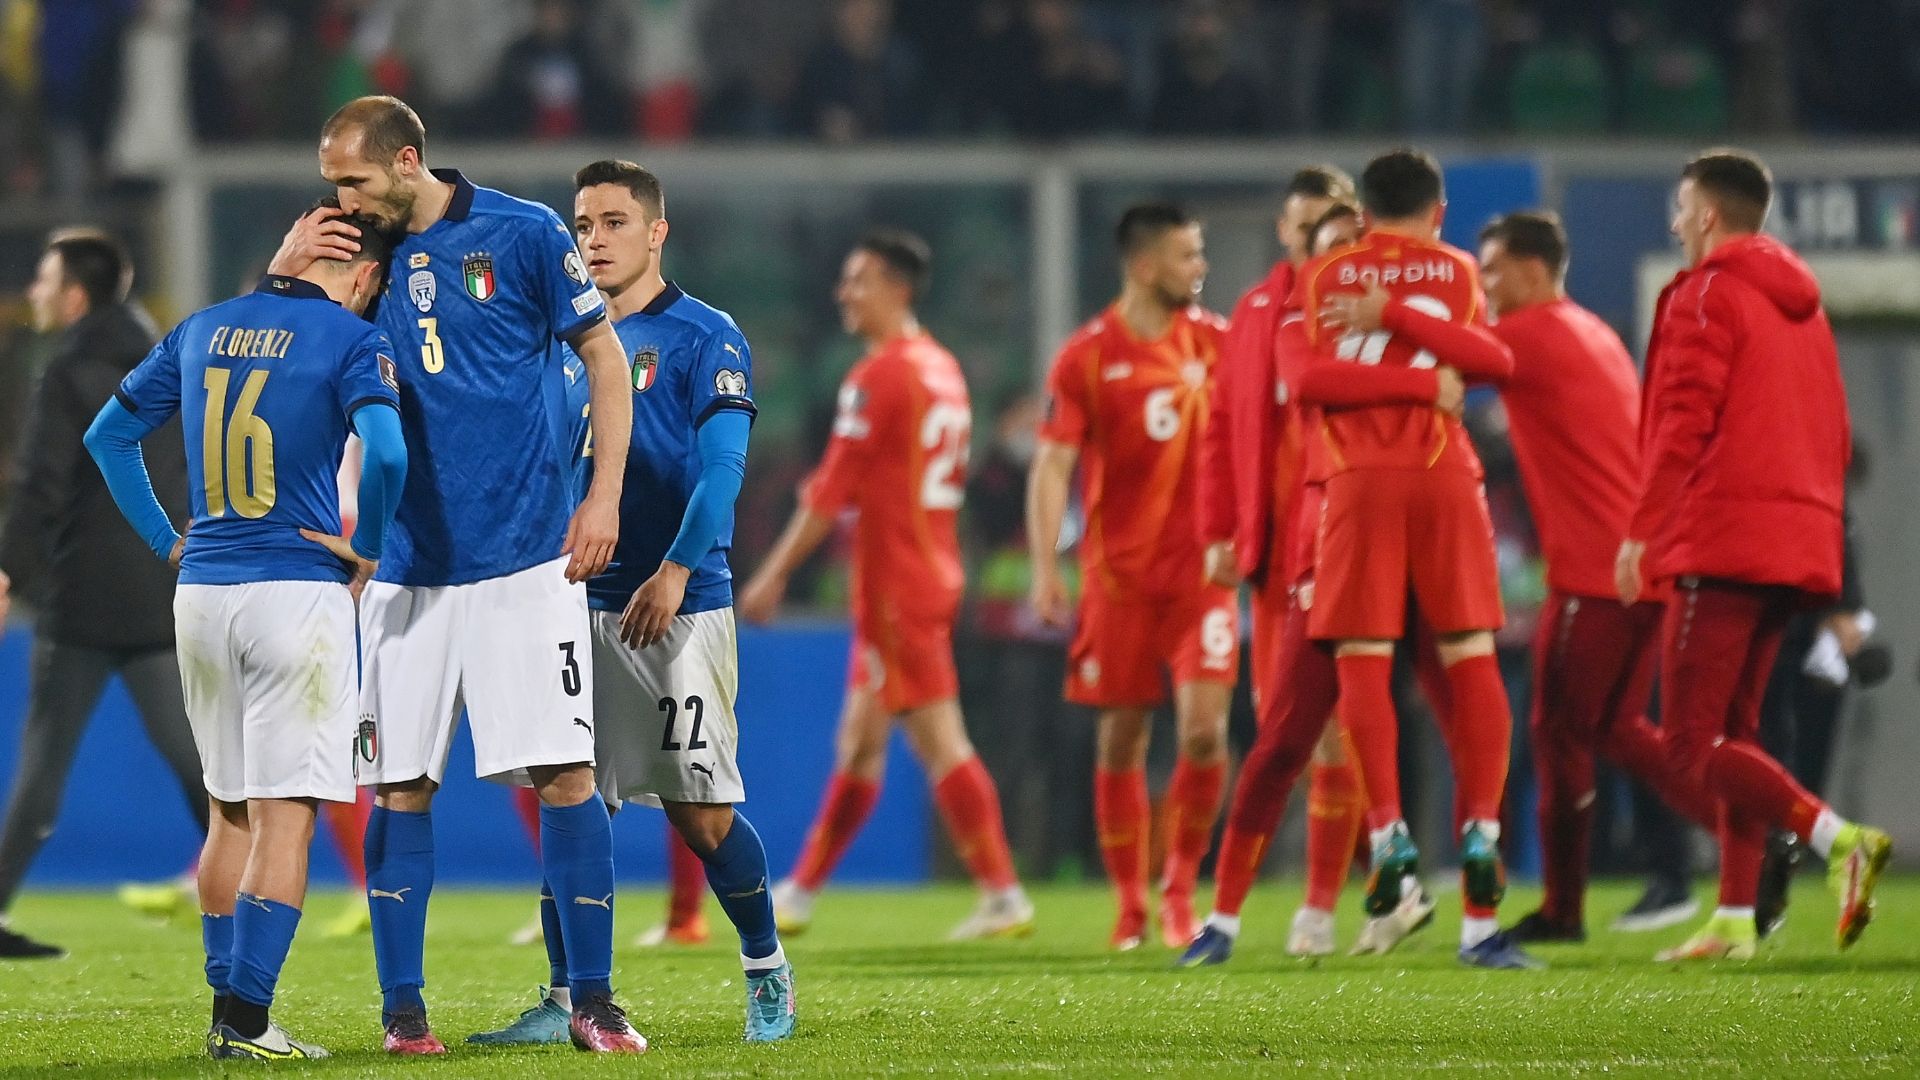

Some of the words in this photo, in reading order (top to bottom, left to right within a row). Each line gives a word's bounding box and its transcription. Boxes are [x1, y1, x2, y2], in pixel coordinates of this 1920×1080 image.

[465, 261, 491, 271] ITALIA
[207, 325, 295, 359] FLORENZI
[417, 316, 445, 375] 3
[1144, 388, 1180, 442] 6
[203, 367, 276, 519] 16
[1201, 608, 1233, 657] 6
[558, 640, 582, 697] 3
[658, 695, 707, 751] 22
